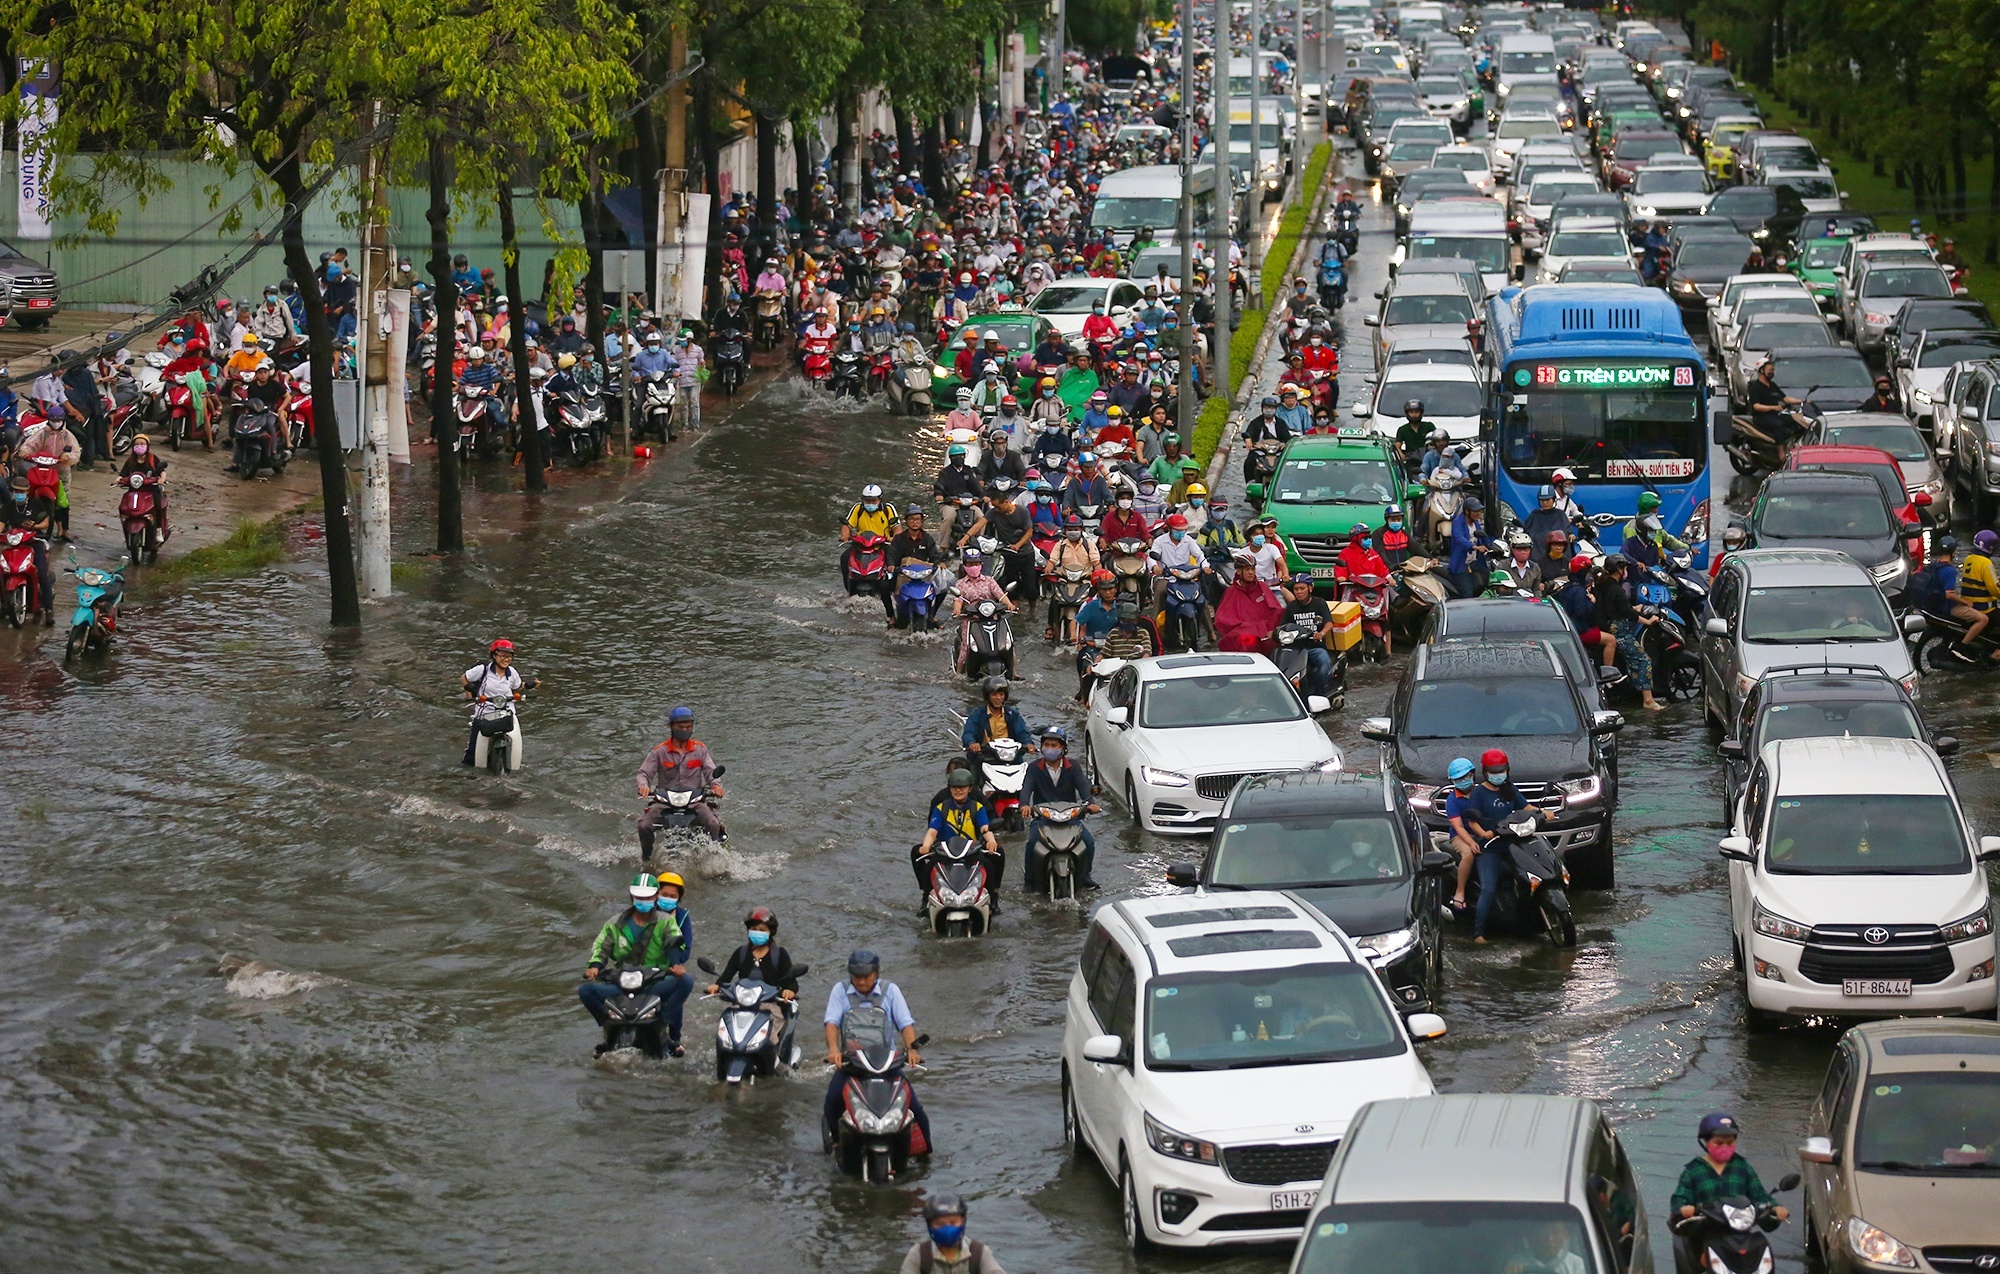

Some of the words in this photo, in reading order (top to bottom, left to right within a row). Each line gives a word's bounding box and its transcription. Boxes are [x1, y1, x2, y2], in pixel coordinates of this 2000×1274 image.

[20, 154, 35, 200] DỤNG
[1536, 365, 1557, 383] 53
[1573, 366, 1615, 383] TRÊN
[1676, 368, 1692, 385] 53
[1608, 460, 1621, 476] BẾN
[1649, 460, 1664, 476] SUỐI
[1665, 462, 1680, 476] TIÊN
[1683, 461, 1693, 475] 53
[1293, 611, 1316, 621] TYRANTS
[1845, 981, 1909, 994] 51F-864.44
